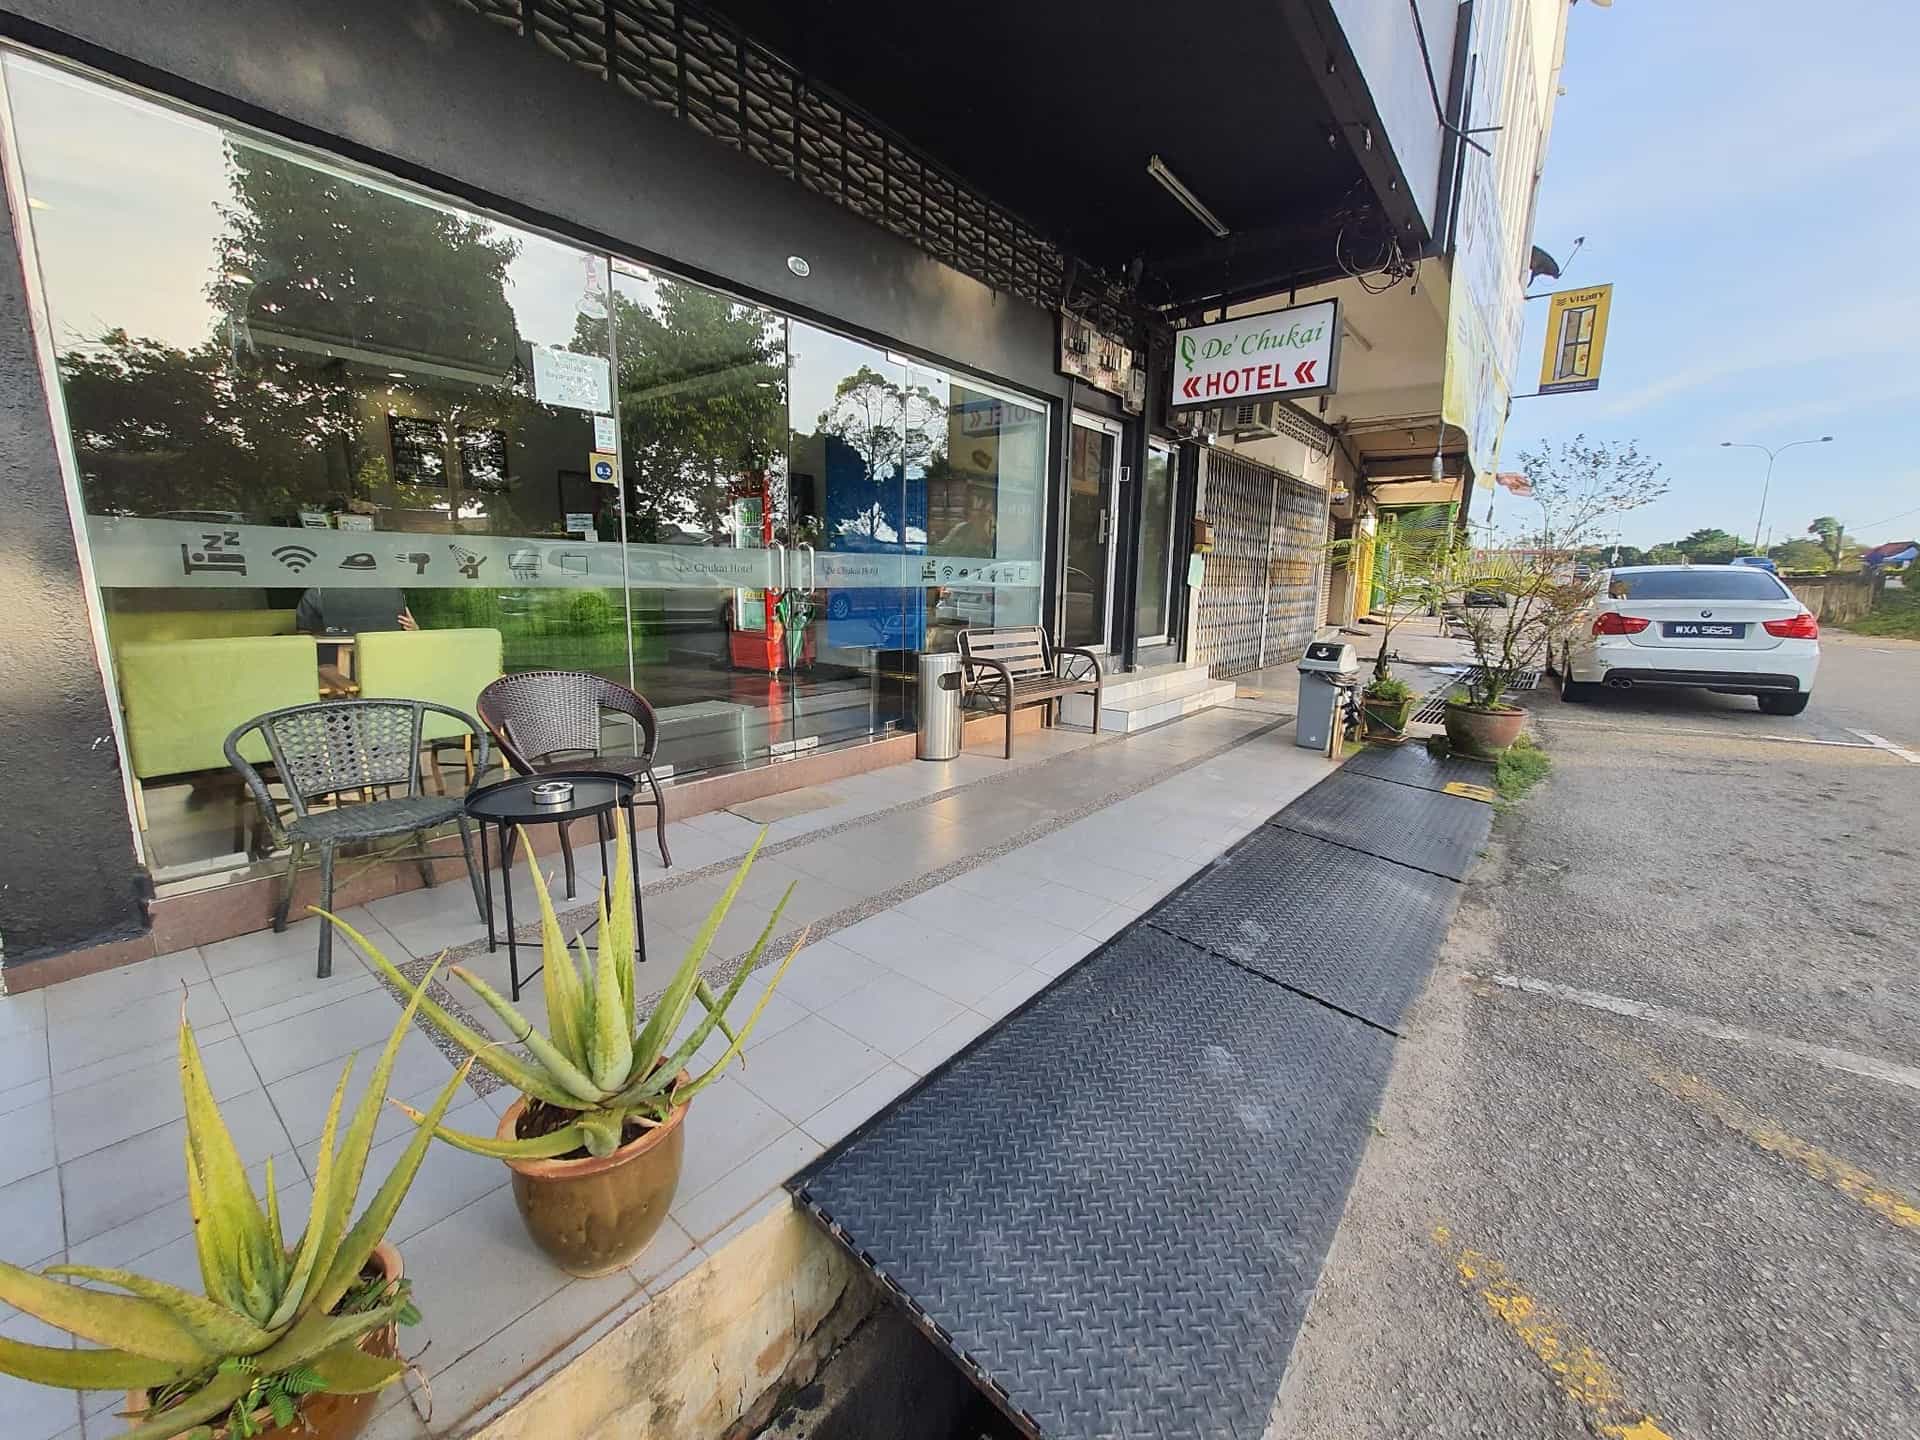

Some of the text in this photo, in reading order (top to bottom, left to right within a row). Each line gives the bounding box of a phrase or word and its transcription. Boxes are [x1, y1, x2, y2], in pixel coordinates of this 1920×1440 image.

[1202, 321, 1326, 359] De' Chukai
[1205, 363, 1288, 397] HOTEL
